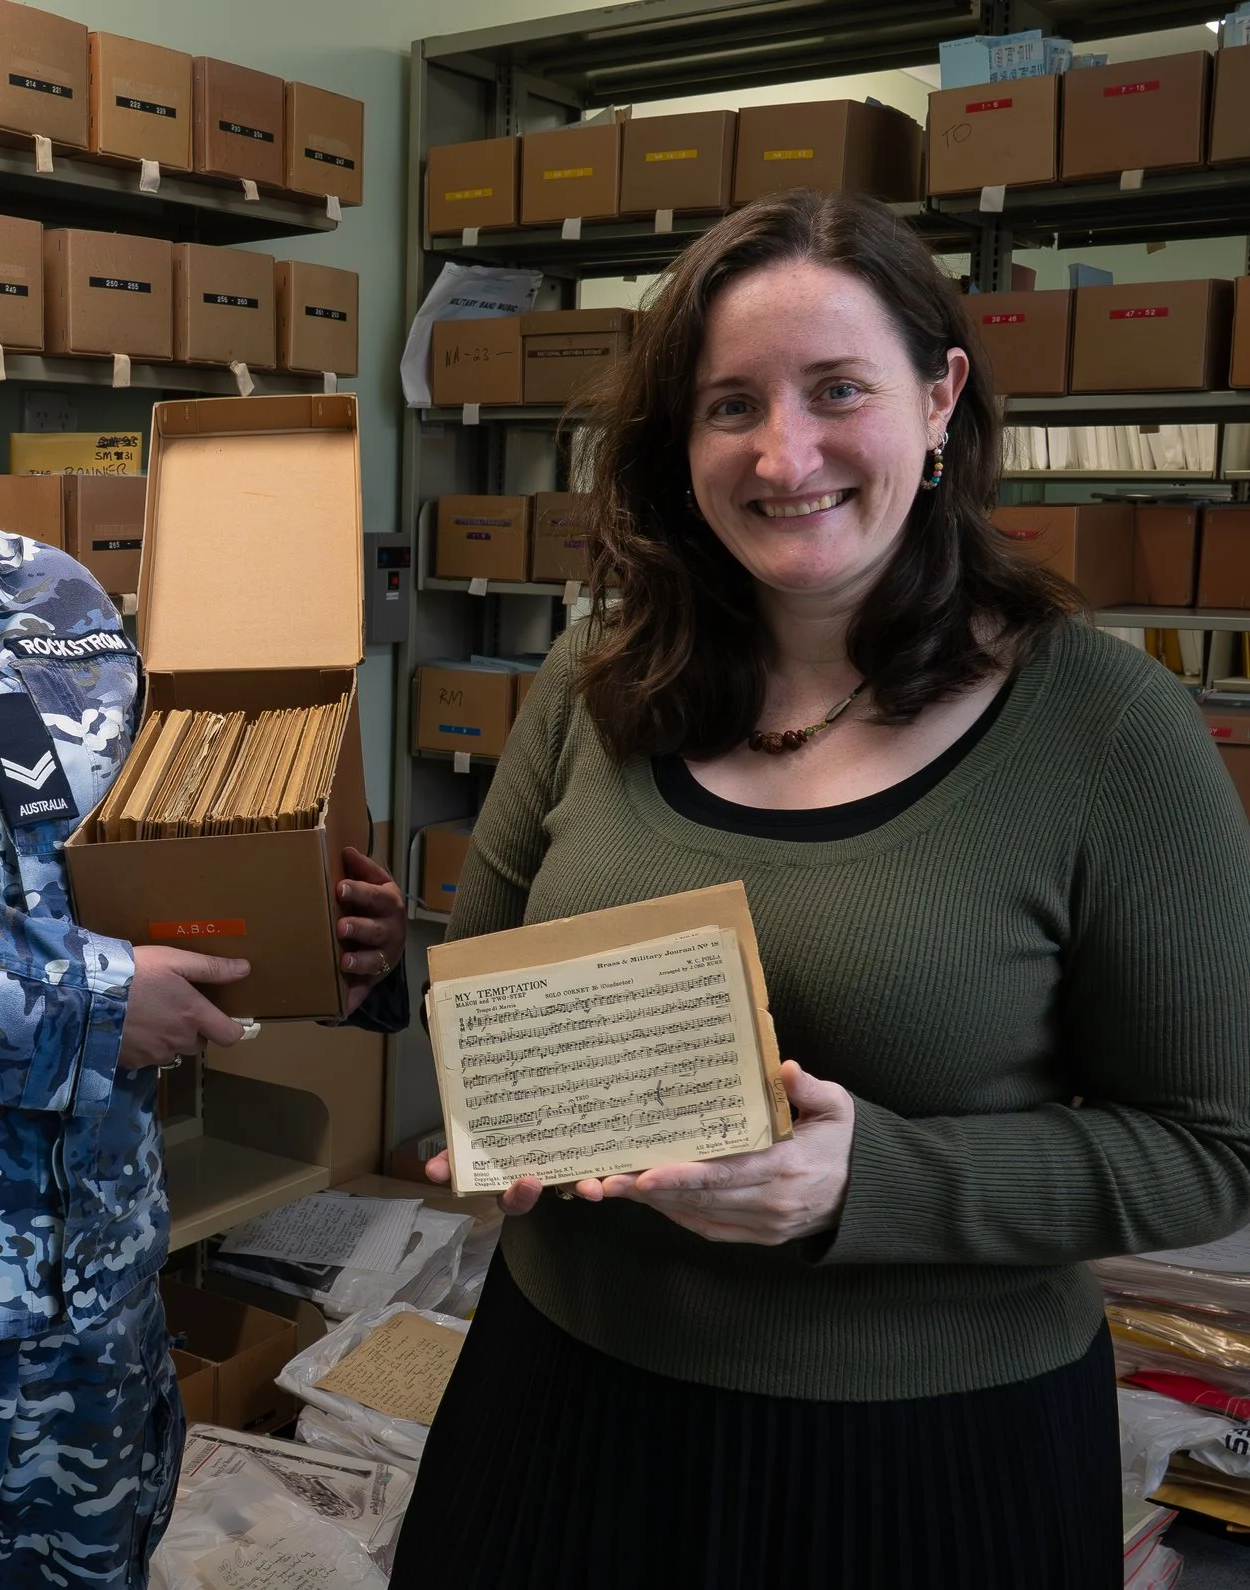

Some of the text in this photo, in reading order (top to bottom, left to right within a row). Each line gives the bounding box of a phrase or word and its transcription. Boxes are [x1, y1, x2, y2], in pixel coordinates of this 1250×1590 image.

[25, 79, 37, 88] 214
[129, 100, 141, 109] 222
[942, 123, 972, 148] TO
[105, 279, 118, 287] 250
[127, 282, 139, 290] 255
[95, 451, 112, 461] SM
[18, 632, 128, 656] ROCKSTROM
[438, 687, 463, 707] RM
[20, 798, 69, 817] AUSTRALIA
[176, 924, 220, 935] A.B.C.
[597, 961, 621, 969] Brass
[630, 952, 662, 963] Military
[664, 945, 695, 956] Journal
[701, 954, 721, 963] POLLA
[658, 967, 681, 976] Arranged
[454, 979, 549, 1003] MY TEMPTATION
[544, 991, 562, 999] SOLO
[563, 986, 590, 996] CORNET
[600, 978, 634, 990] (Conductor)
[455, 999, 478, 1009] MARCH
[492, 992, 527, 1003] TWO-STEP
